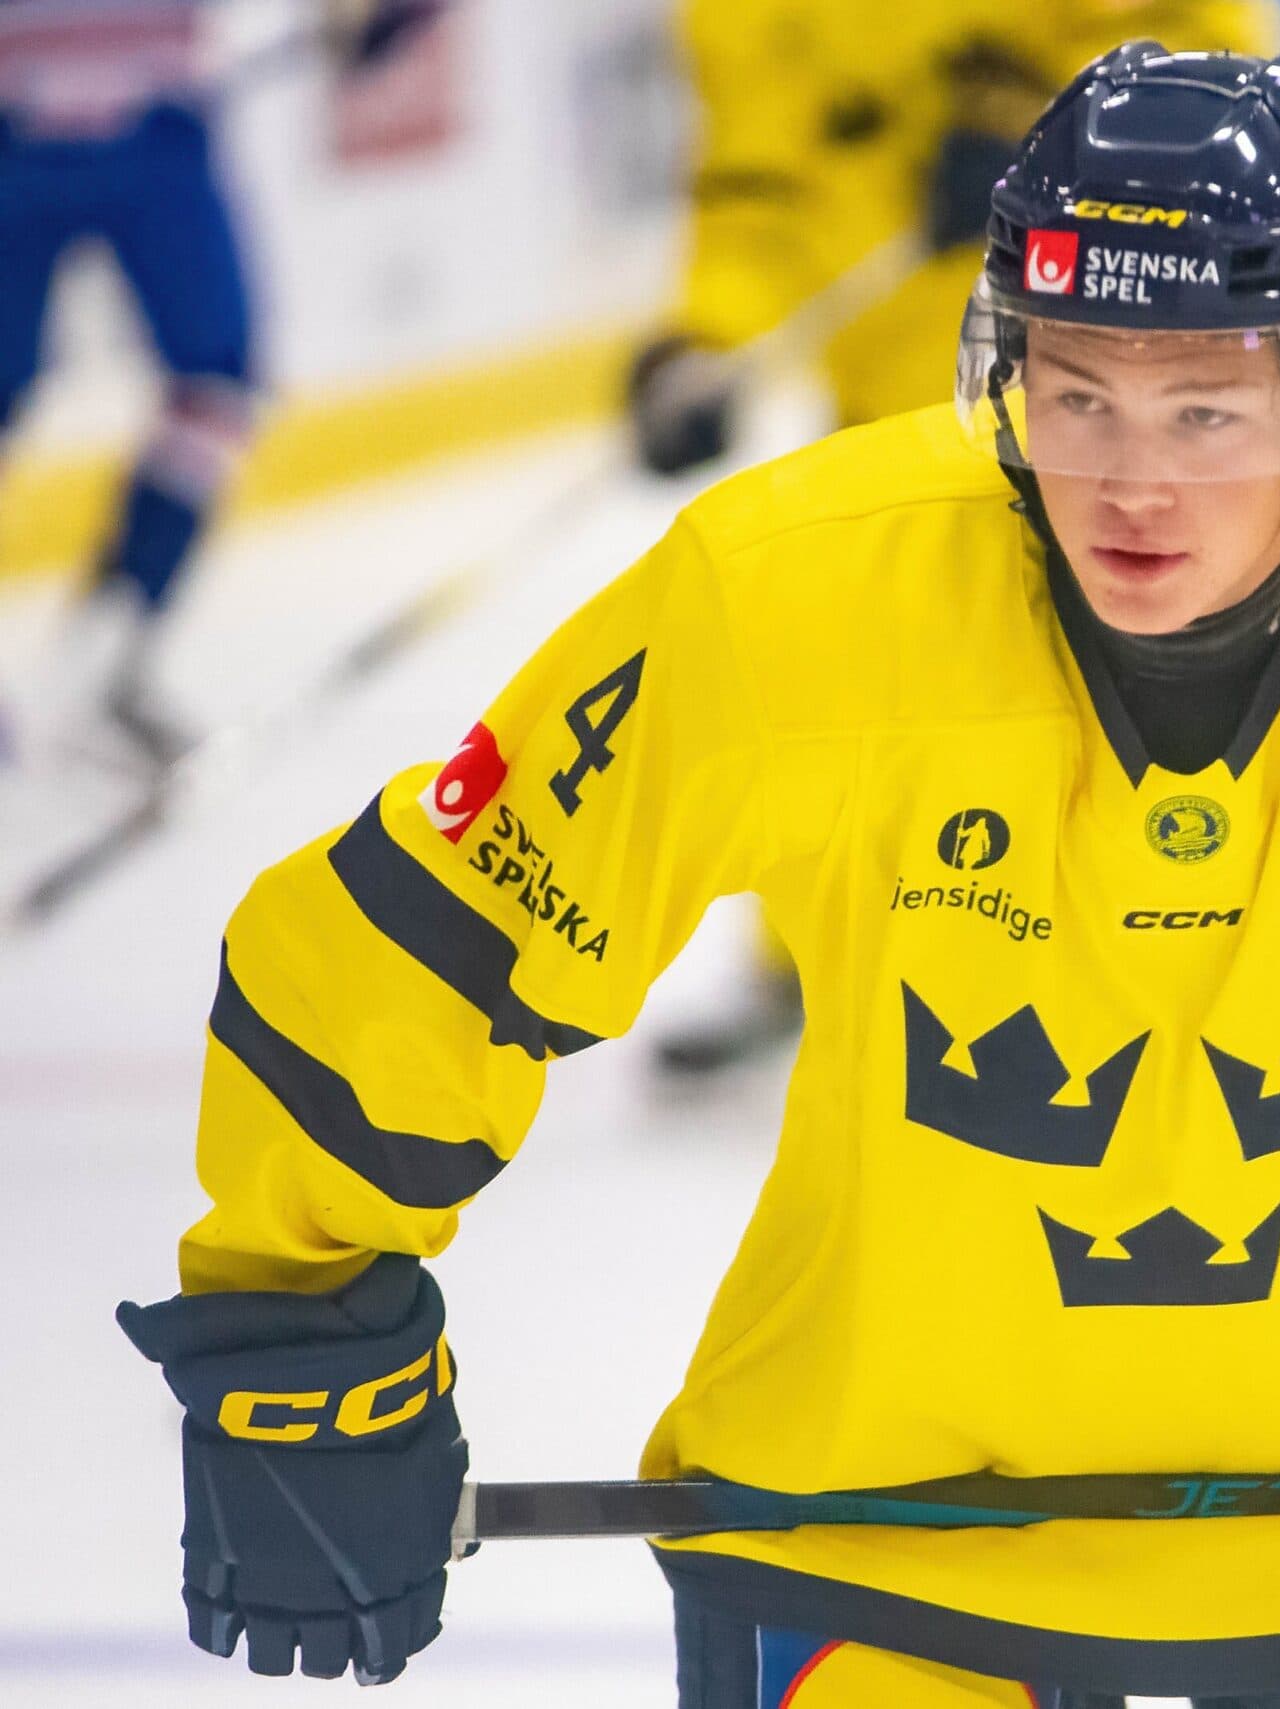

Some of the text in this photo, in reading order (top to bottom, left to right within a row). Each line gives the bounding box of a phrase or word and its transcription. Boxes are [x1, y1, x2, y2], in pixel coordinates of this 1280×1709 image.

[1074, 199, 1188, 229] CCM
[1086, 246, 1220, 285] SVENSKA
[1083, 273, 1152, 304] SPEL
[548, 647, 648, 818] 4
[1122, 907, 1245, 931] CCM
[217, 1330, 453, 1443] CC
